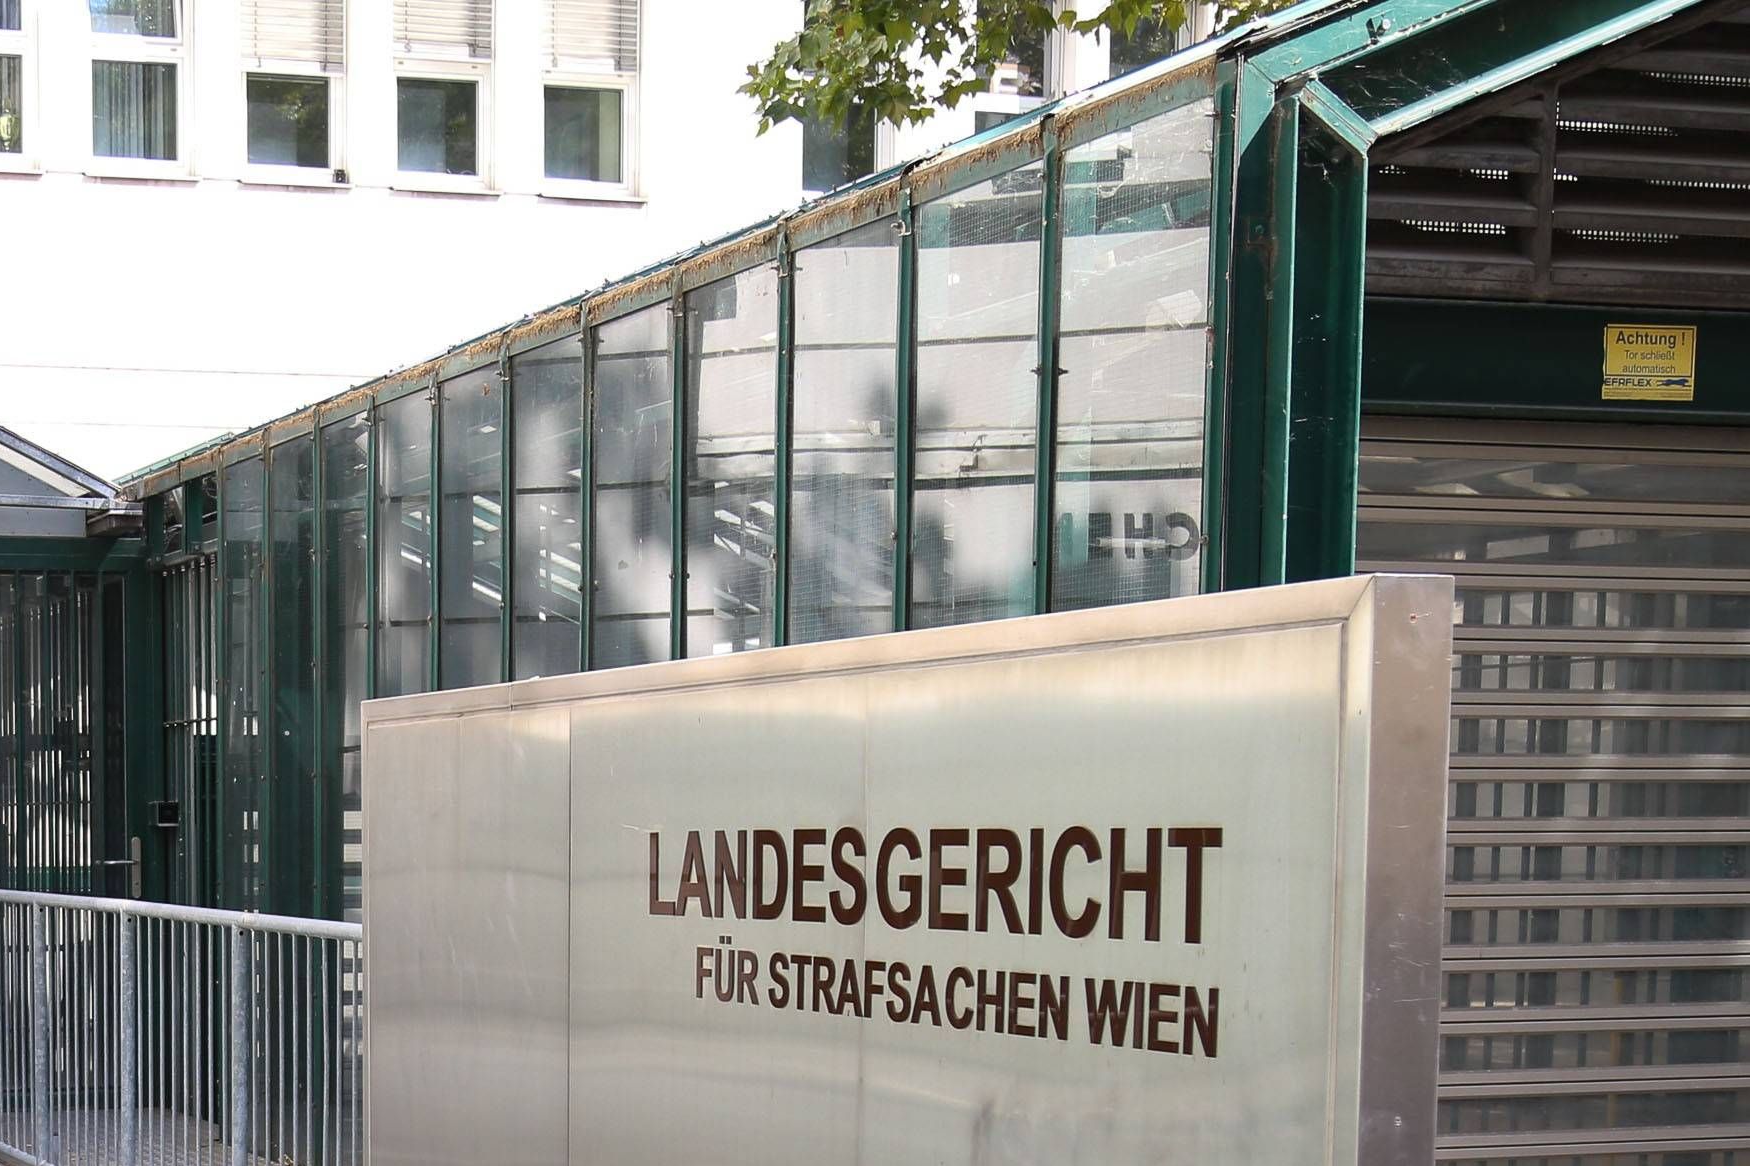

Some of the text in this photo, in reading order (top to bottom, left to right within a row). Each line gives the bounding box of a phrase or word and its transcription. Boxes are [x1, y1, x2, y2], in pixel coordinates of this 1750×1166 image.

[1615, 330, 1677, 348] Achtung
[1624, 349, 1675, 361] Tor schließt
[1622, 364, 1676, 374] automatisch
[648, 826, 1223, 945] LANDESGERICHT
[695, 935, 1220, 1059] FÜR STRAFSACHEN WIEN
